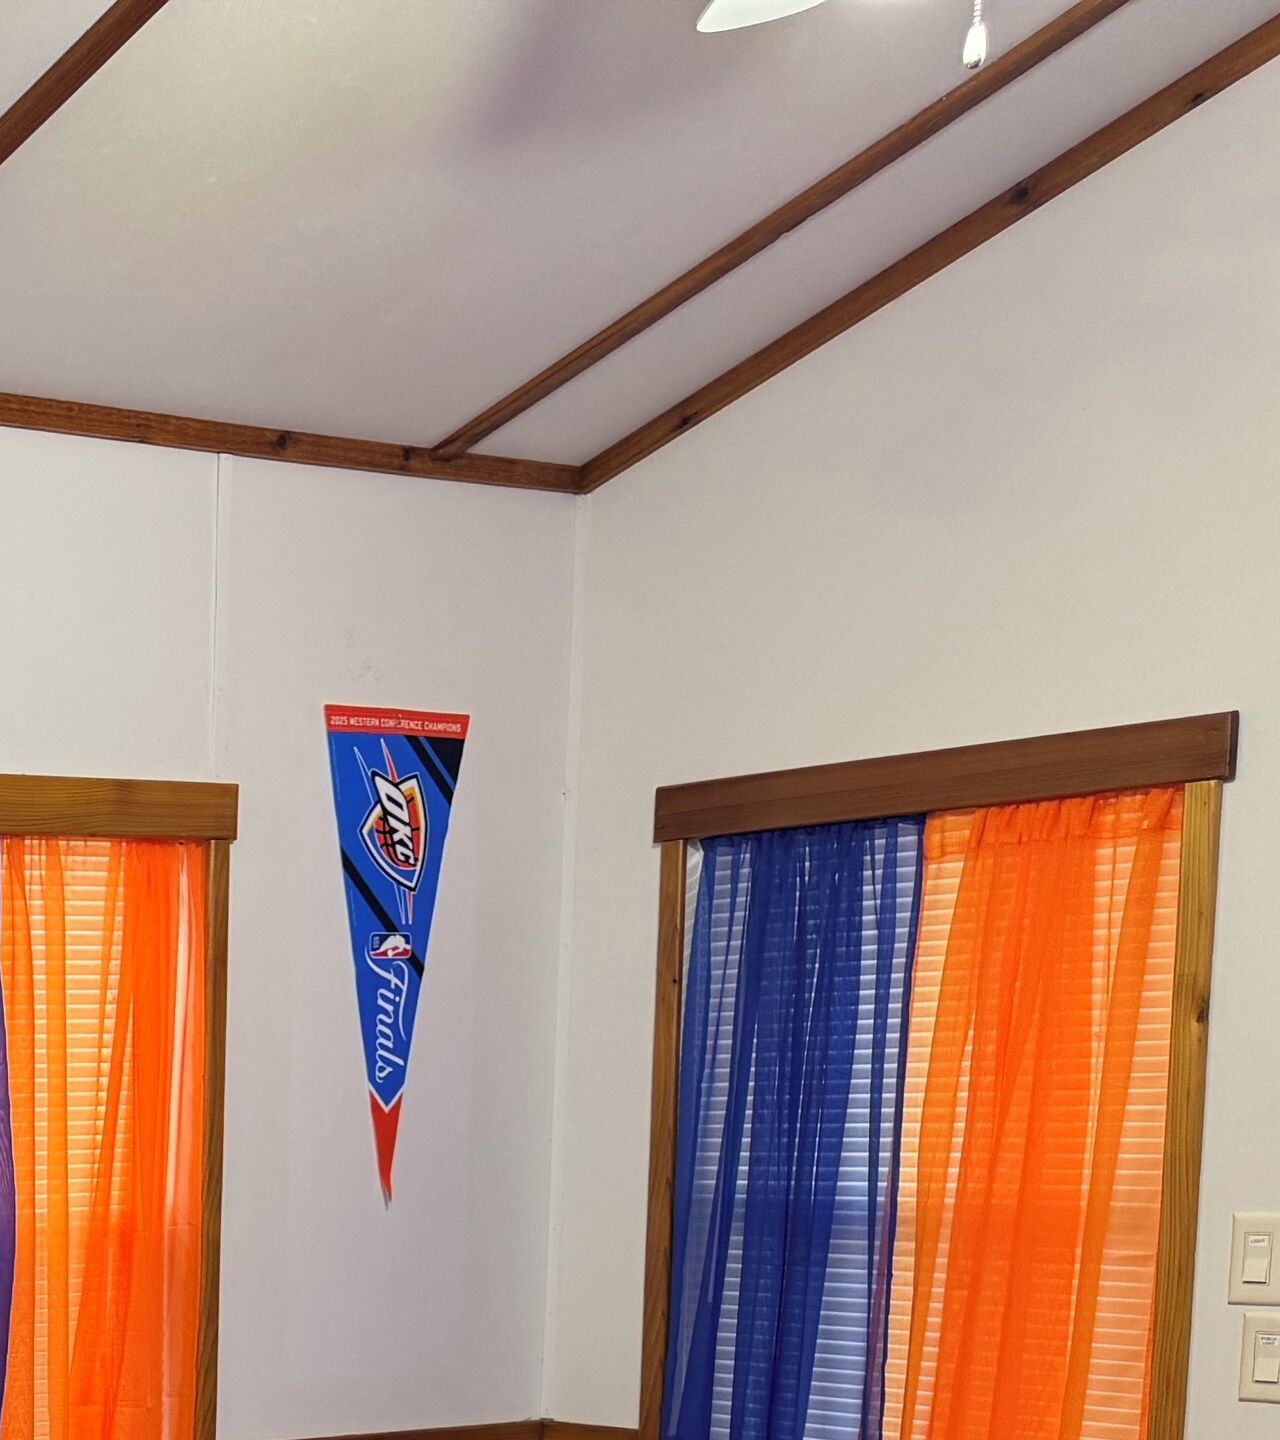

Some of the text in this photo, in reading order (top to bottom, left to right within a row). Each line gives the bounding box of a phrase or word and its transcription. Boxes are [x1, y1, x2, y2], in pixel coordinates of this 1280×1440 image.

[330, 715, 348, 726] 2025
[349, 716, 379, 728] WESTERN
[424, 720, 462, 733] CHAMPIONS
[374, 776, 416, 867] OKC
[364, 945, 407, 1083] Finals
